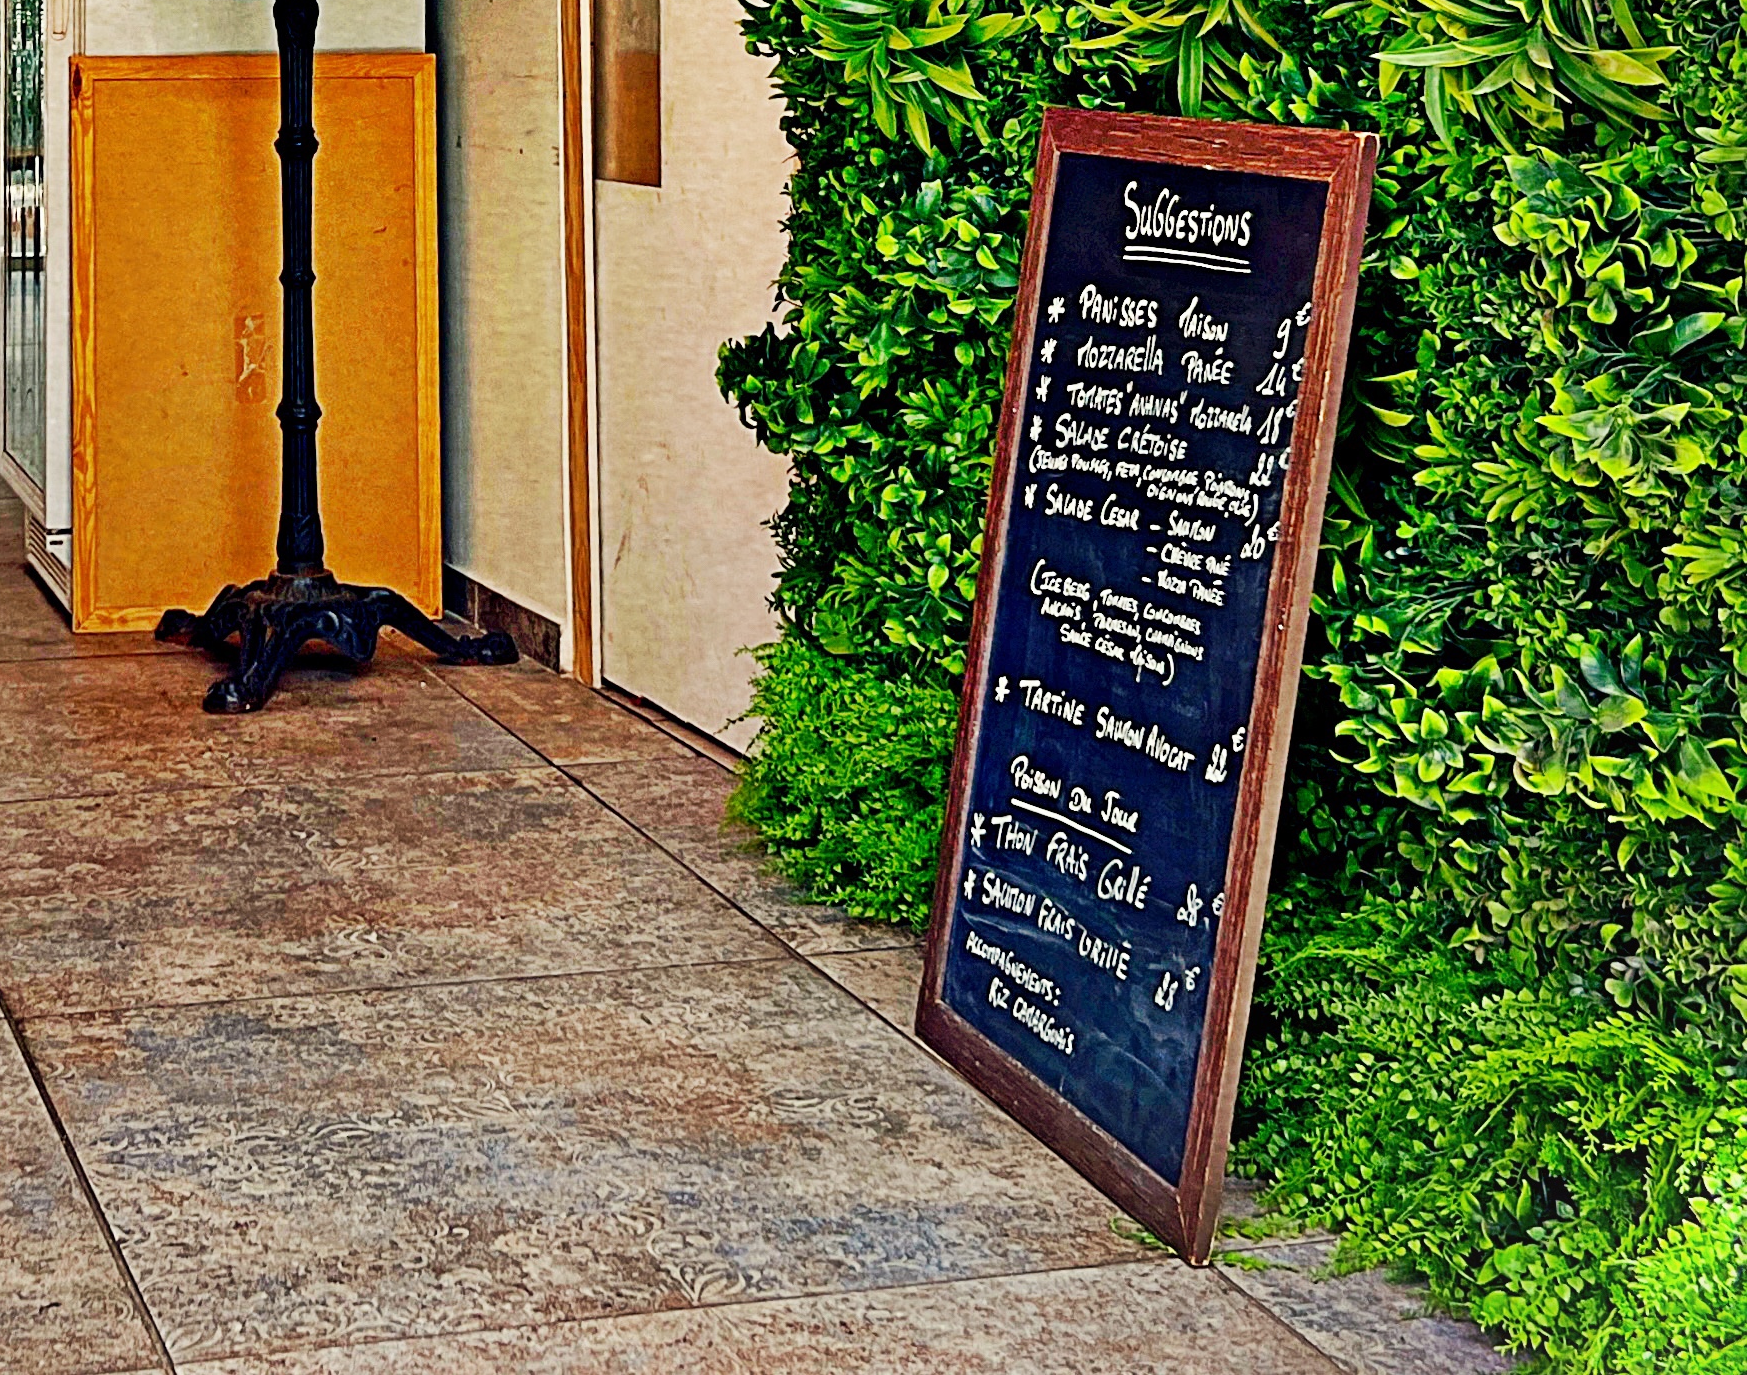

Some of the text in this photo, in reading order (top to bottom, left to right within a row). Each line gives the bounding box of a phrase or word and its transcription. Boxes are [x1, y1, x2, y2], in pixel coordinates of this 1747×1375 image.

[1079, 284, 1158, 328] PANISSES
[1181, 347, 1234, 384] PANÉE
[1067, 382, 1123, 416] TOMATES
[1055, 413, 1110, 451] SALADE
[1117, 424, 1188, 461] CRÉTOISE
[1044, 483, 1093, 521] SALADE
[1100, 493, 1140, 531] CESAR
[1019, 679, 1084, 725] TARTINE
[1145, 725, 1196, 771] AVOCAT
[991, 815, 1038, 856] THON
[1047, 832, 1089, 881] FRAIS
[1037, 899, 1075, 940] FRAIS
